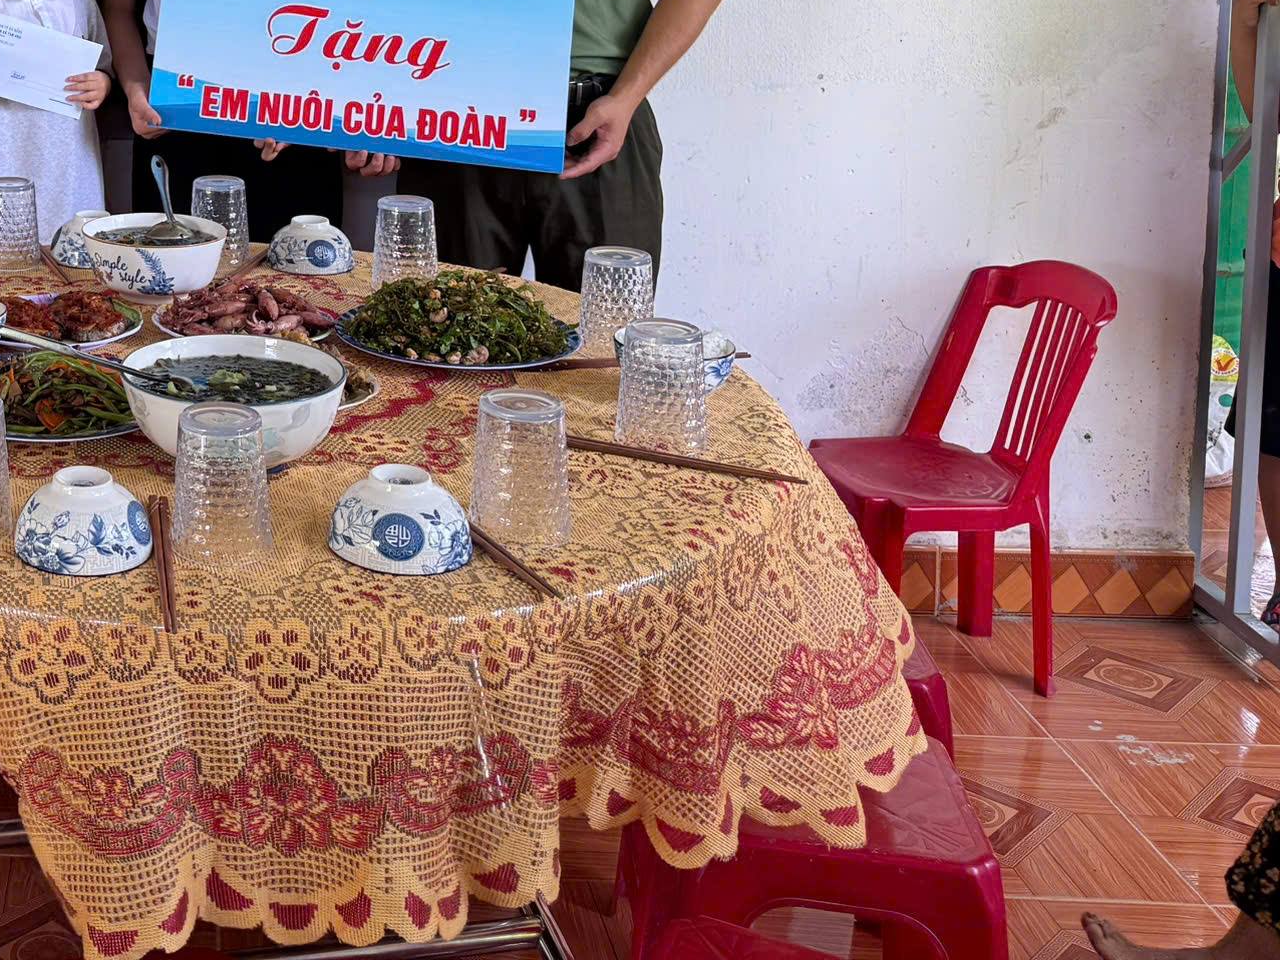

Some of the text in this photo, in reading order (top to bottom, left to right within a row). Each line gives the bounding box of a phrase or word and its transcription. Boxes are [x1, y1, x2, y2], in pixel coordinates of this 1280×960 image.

[267, 4, 451, 80] Tặng
[257, 89, 333, 131] NUÔI
[343, 92, 406, 139] CỦA
